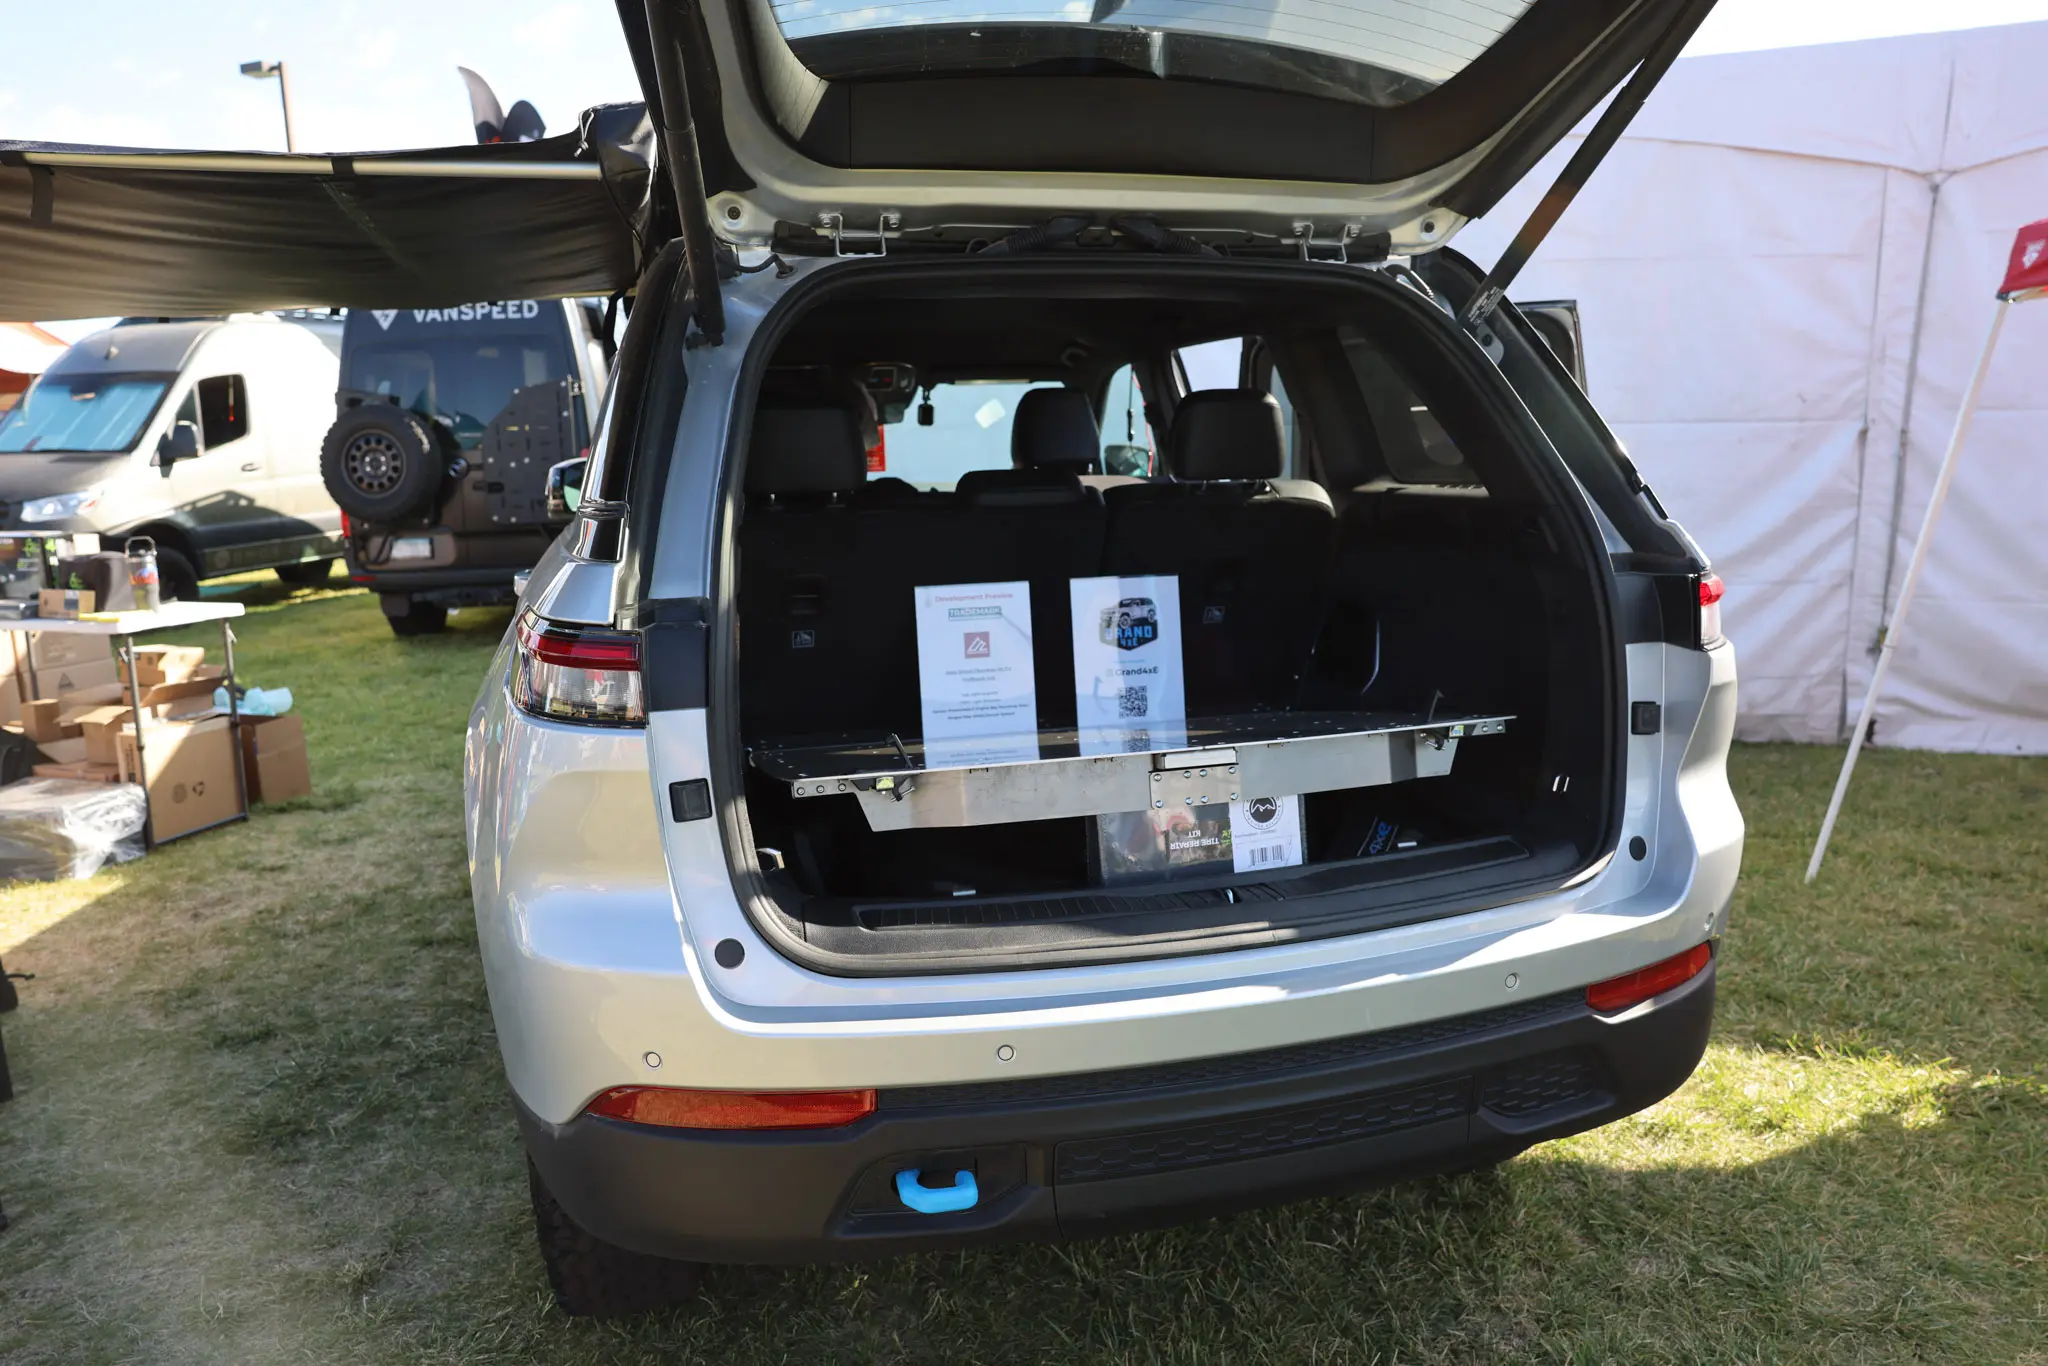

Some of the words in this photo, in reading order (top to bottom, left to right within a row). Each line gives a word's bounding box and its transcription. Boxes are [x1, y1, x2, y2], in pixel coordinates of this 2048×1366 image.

[413, 300, 539, 323] VANSPEED
[950, 607, 1000, 617] TRADEMARK
[1188, 829, 1201, 838] KIT
[1170, 839, 1200, 850] REPAIR
[1201, 837, 1220, 846] TIRE
